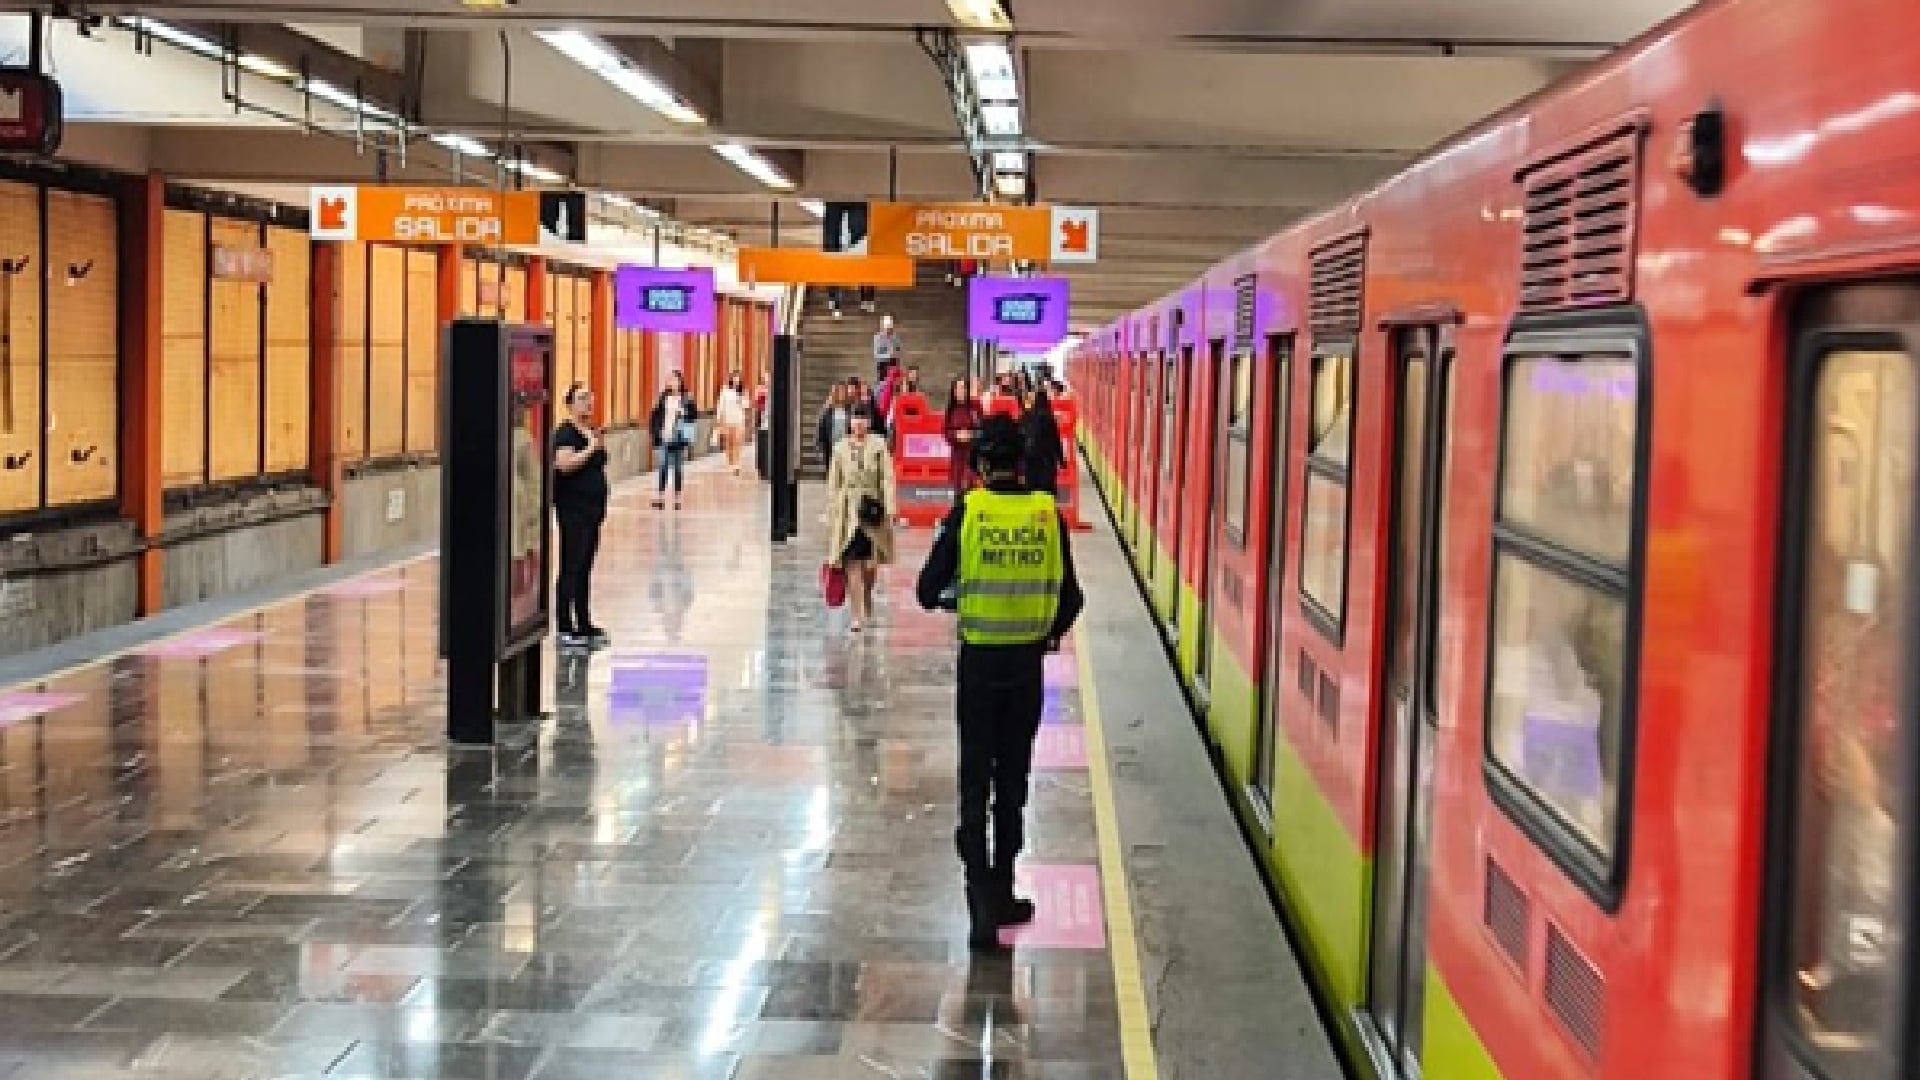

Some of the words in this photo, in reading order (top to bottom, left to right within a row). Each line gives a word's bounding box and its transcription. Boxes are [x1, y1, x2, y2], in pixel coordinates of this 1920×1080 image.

[394, 215, 501, 240] SALIDA
[905, 232, 1014, 256] SALIDA
[982, 549, 1044, 568] METRO
